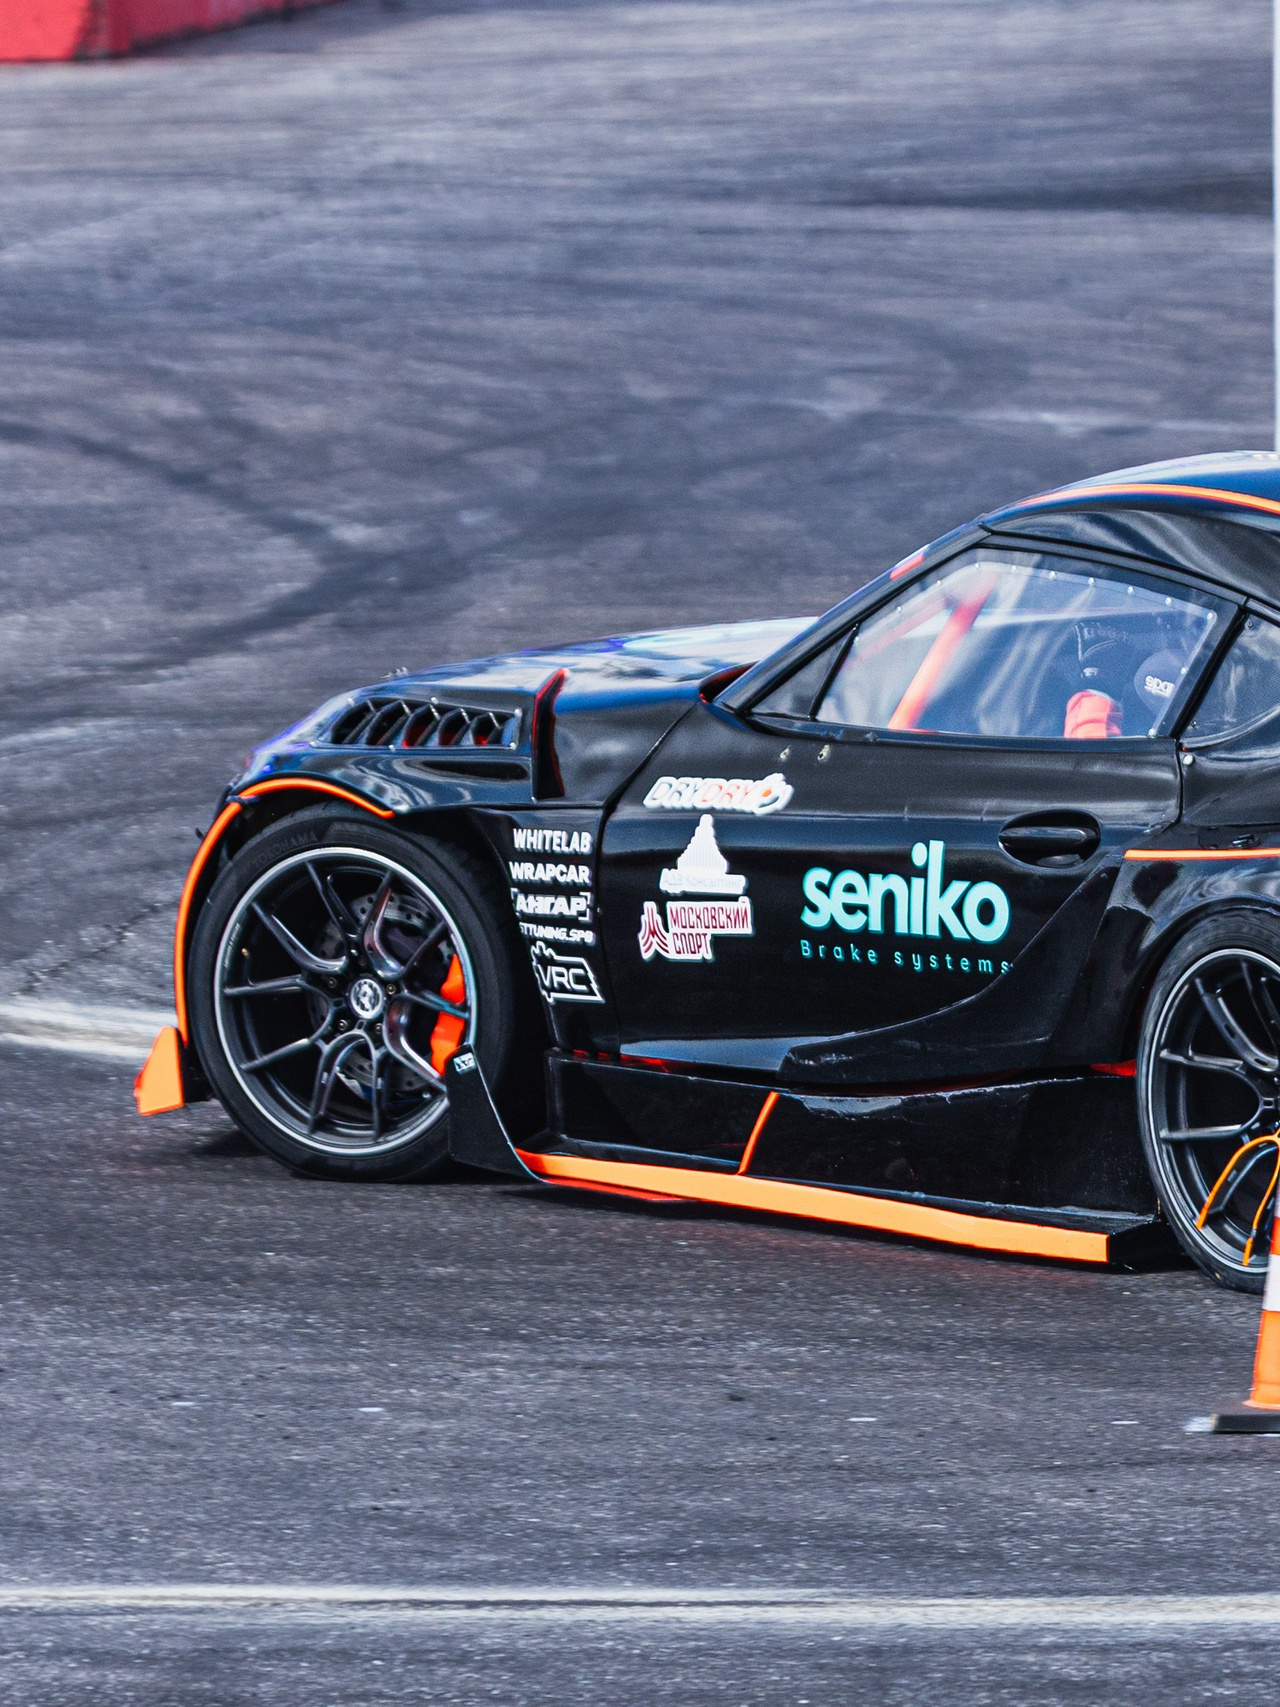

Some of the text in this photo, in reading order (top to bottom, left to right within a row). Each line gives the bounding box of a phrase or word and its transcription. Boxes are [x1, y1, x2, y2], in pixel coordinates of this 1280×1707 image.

[513, 828, 592, 854] WHITELAB
[509, 861, 592, 885] WRAPCAR
[800, 839, 1010, 943] seniko
[669, 900, 750, 930] МОСКОВСКИЙ
[672, 932, 710, 956] СПОРТ
[800, 939, 1011, 975] Brake systems
[536, 964, 589, 991] VRC
